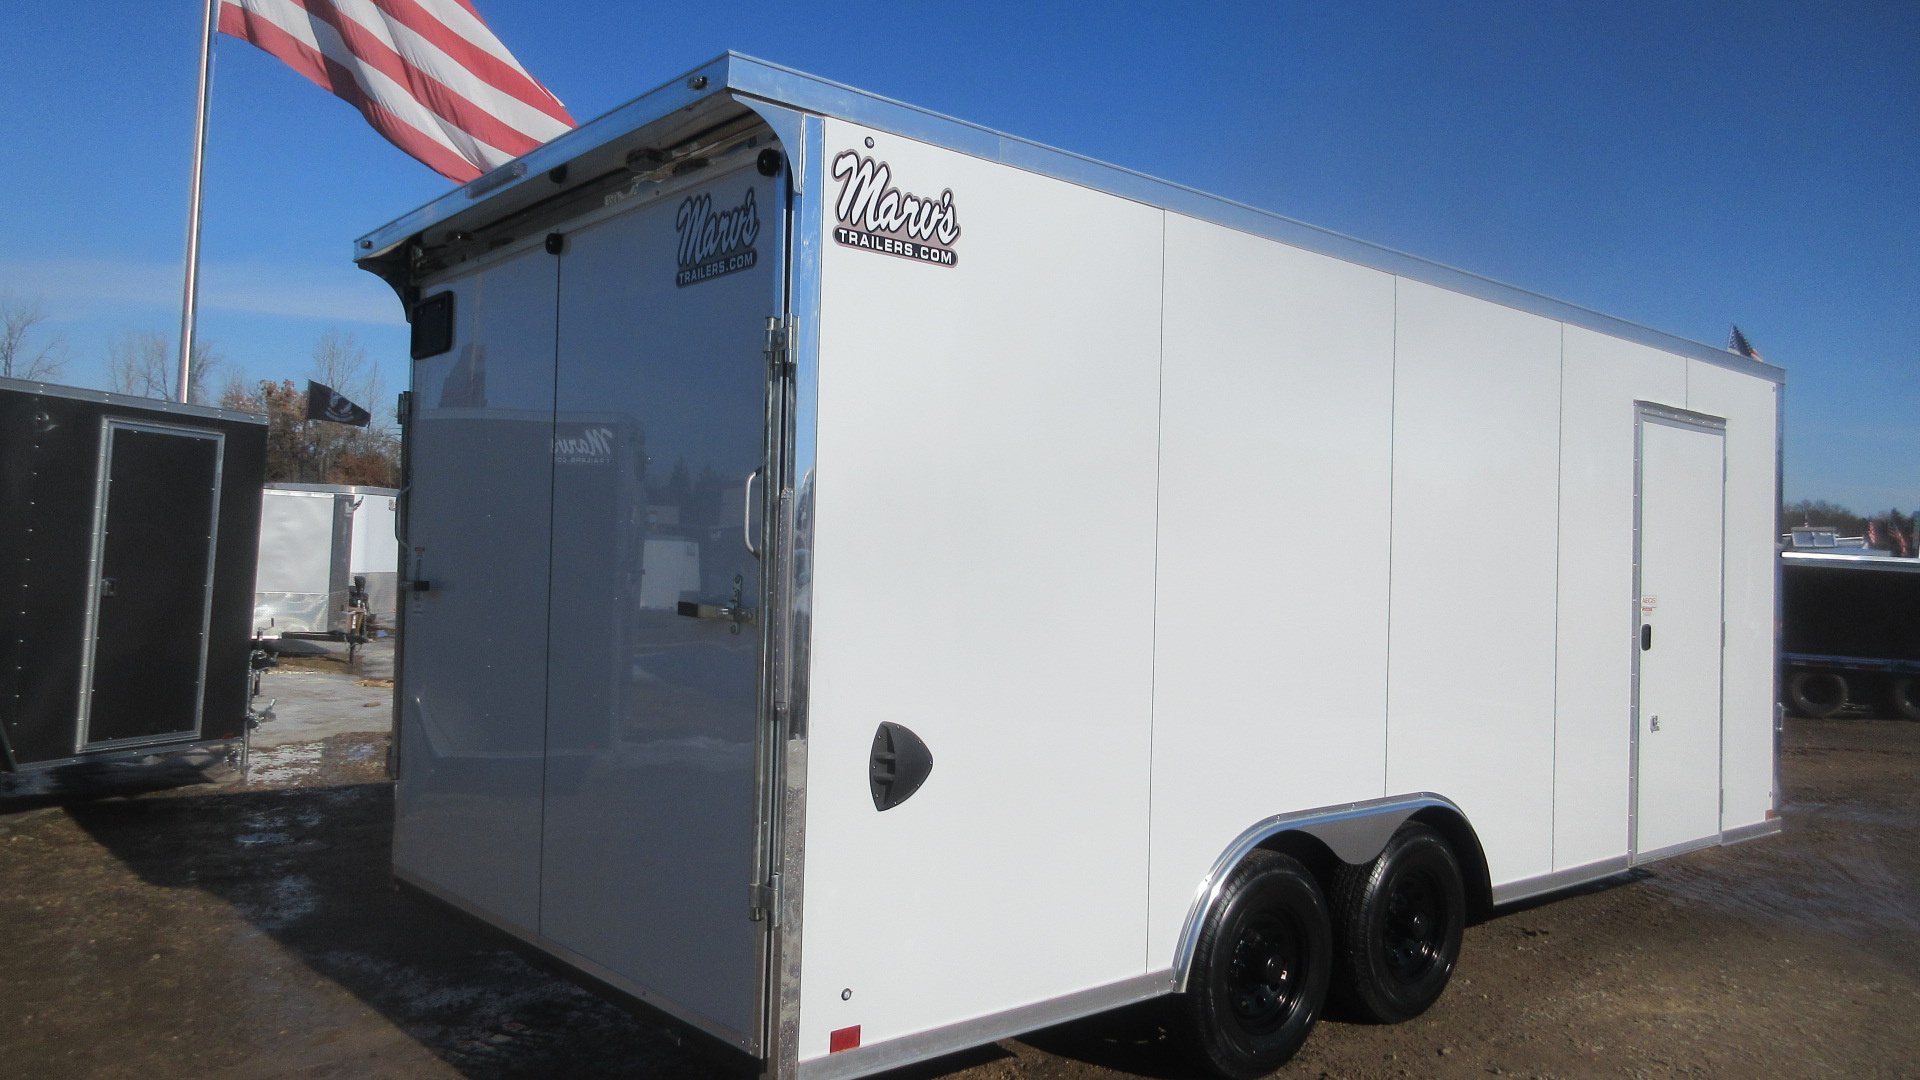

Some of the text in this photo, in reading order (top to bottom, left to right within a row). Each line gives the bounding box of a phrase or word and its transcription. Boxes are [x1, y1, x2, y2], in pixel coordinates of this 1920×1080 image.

[834, 151, 960, 245] Marv's
[677, 188, 758, 265] Marv's
[838, 229, 952, 265] TRAILERS.COM
[679, 252, 754, 285] TRAILERS.COM
